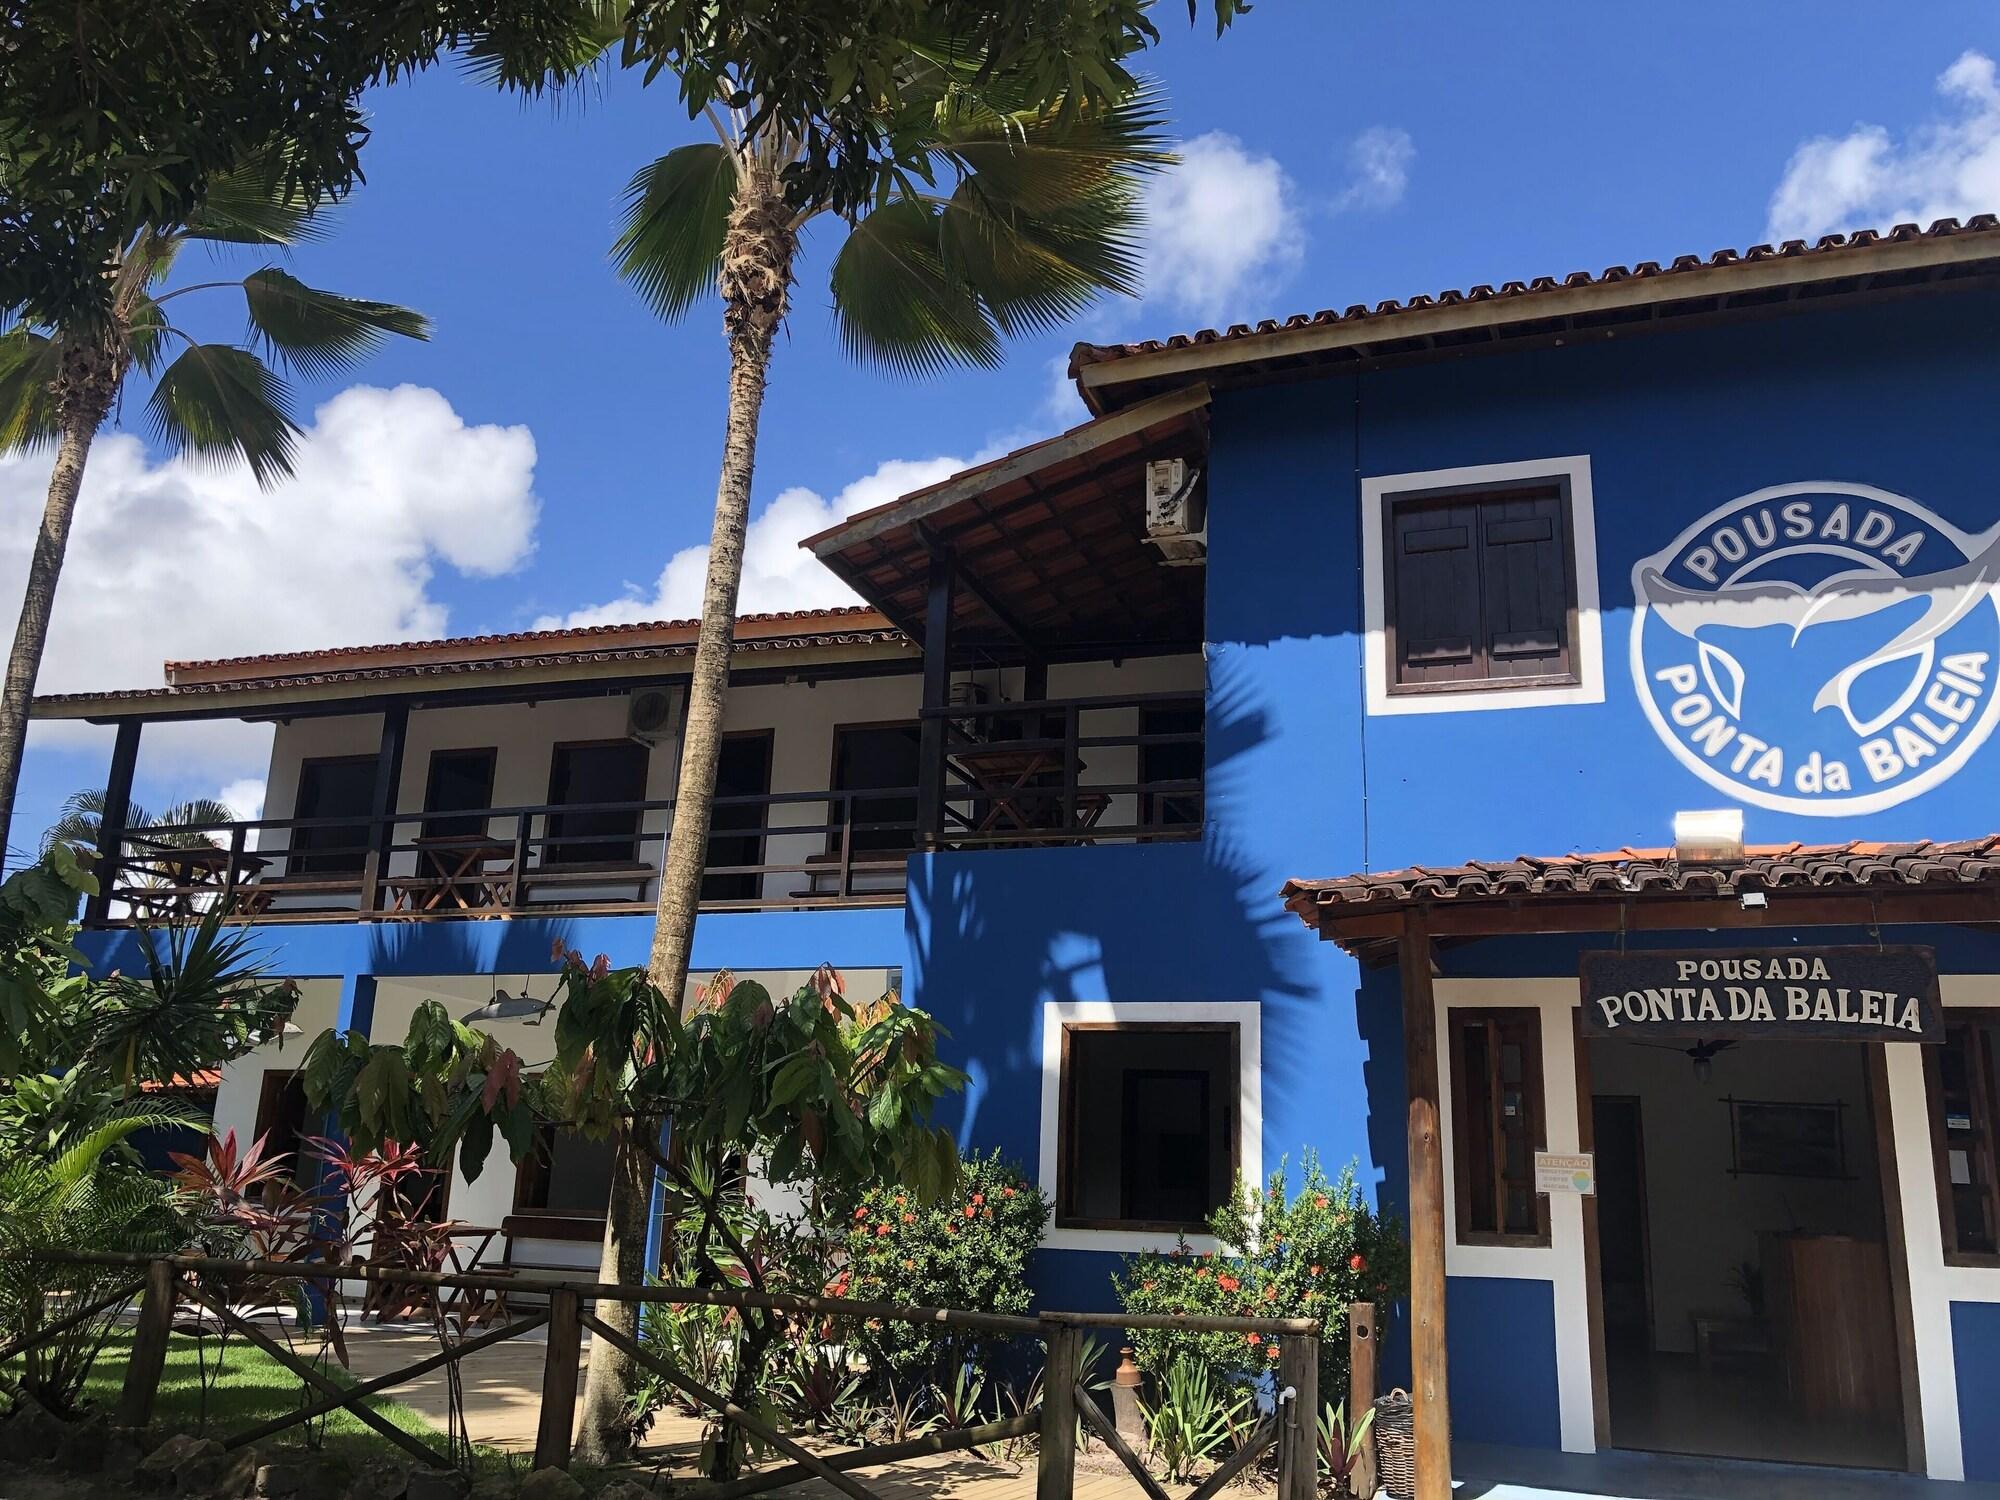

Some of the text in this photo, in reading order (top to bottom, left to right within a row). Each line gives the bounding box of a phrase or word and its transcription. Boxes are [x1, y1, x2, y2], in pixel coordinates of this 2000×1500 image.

[1683, 502, 1925, 583] POUSADA
[1656, 652, 1990, 793] PONTA da BALEIA
[1676, 958, 1831, 981] POUSADA
[1597, 986, 1923, 1033] PONTA DA BALEIA
